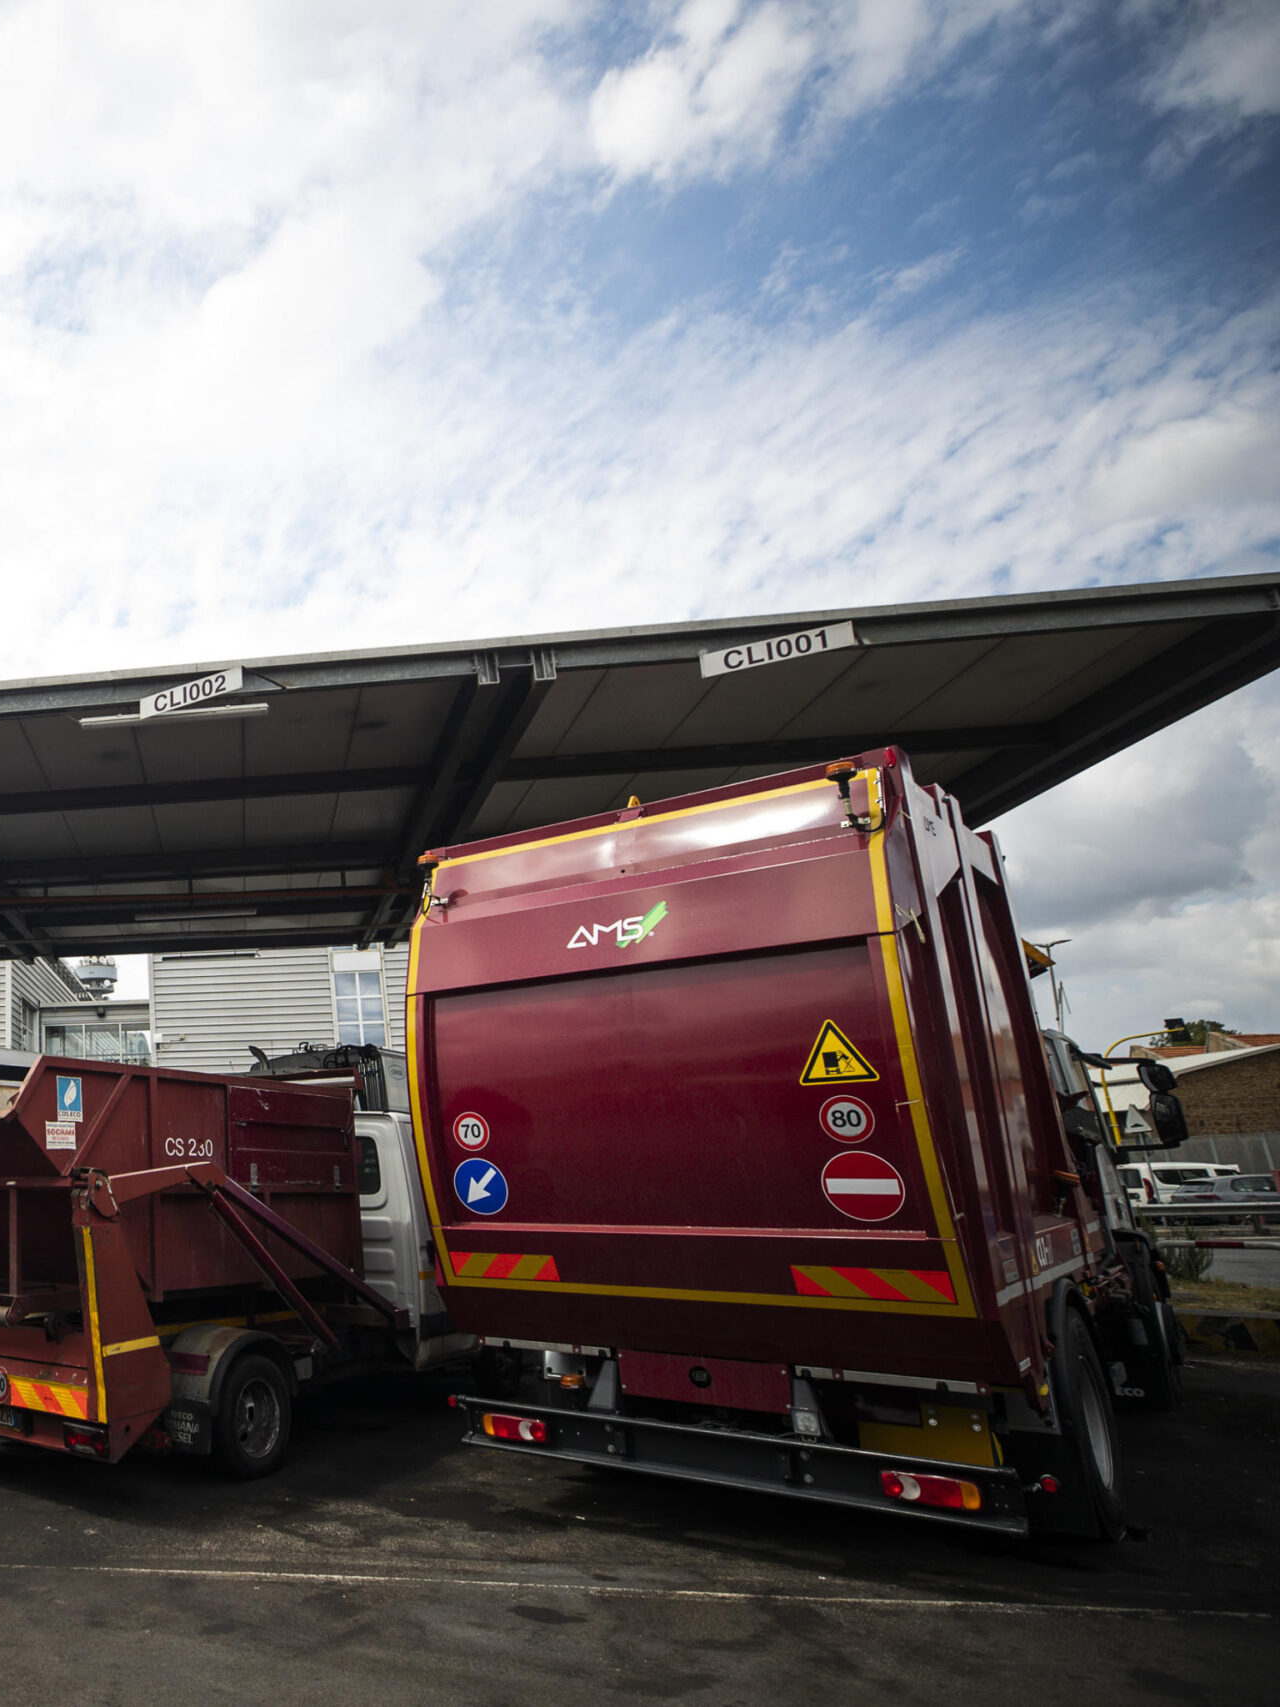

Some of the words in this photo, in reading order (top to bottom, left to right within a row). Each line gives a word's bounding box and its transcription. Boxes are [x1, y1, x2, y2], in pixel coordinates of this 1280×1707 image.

[723, 629, 828, 669] CLI001
[154, 675, 226, 712] CLI002
[566, 914, 645, 949] AMS
[460, 1122, 482, 1139] 70
[831, 1109, 862, 1128] 80
[165, 1137, 185, 1157] CS
